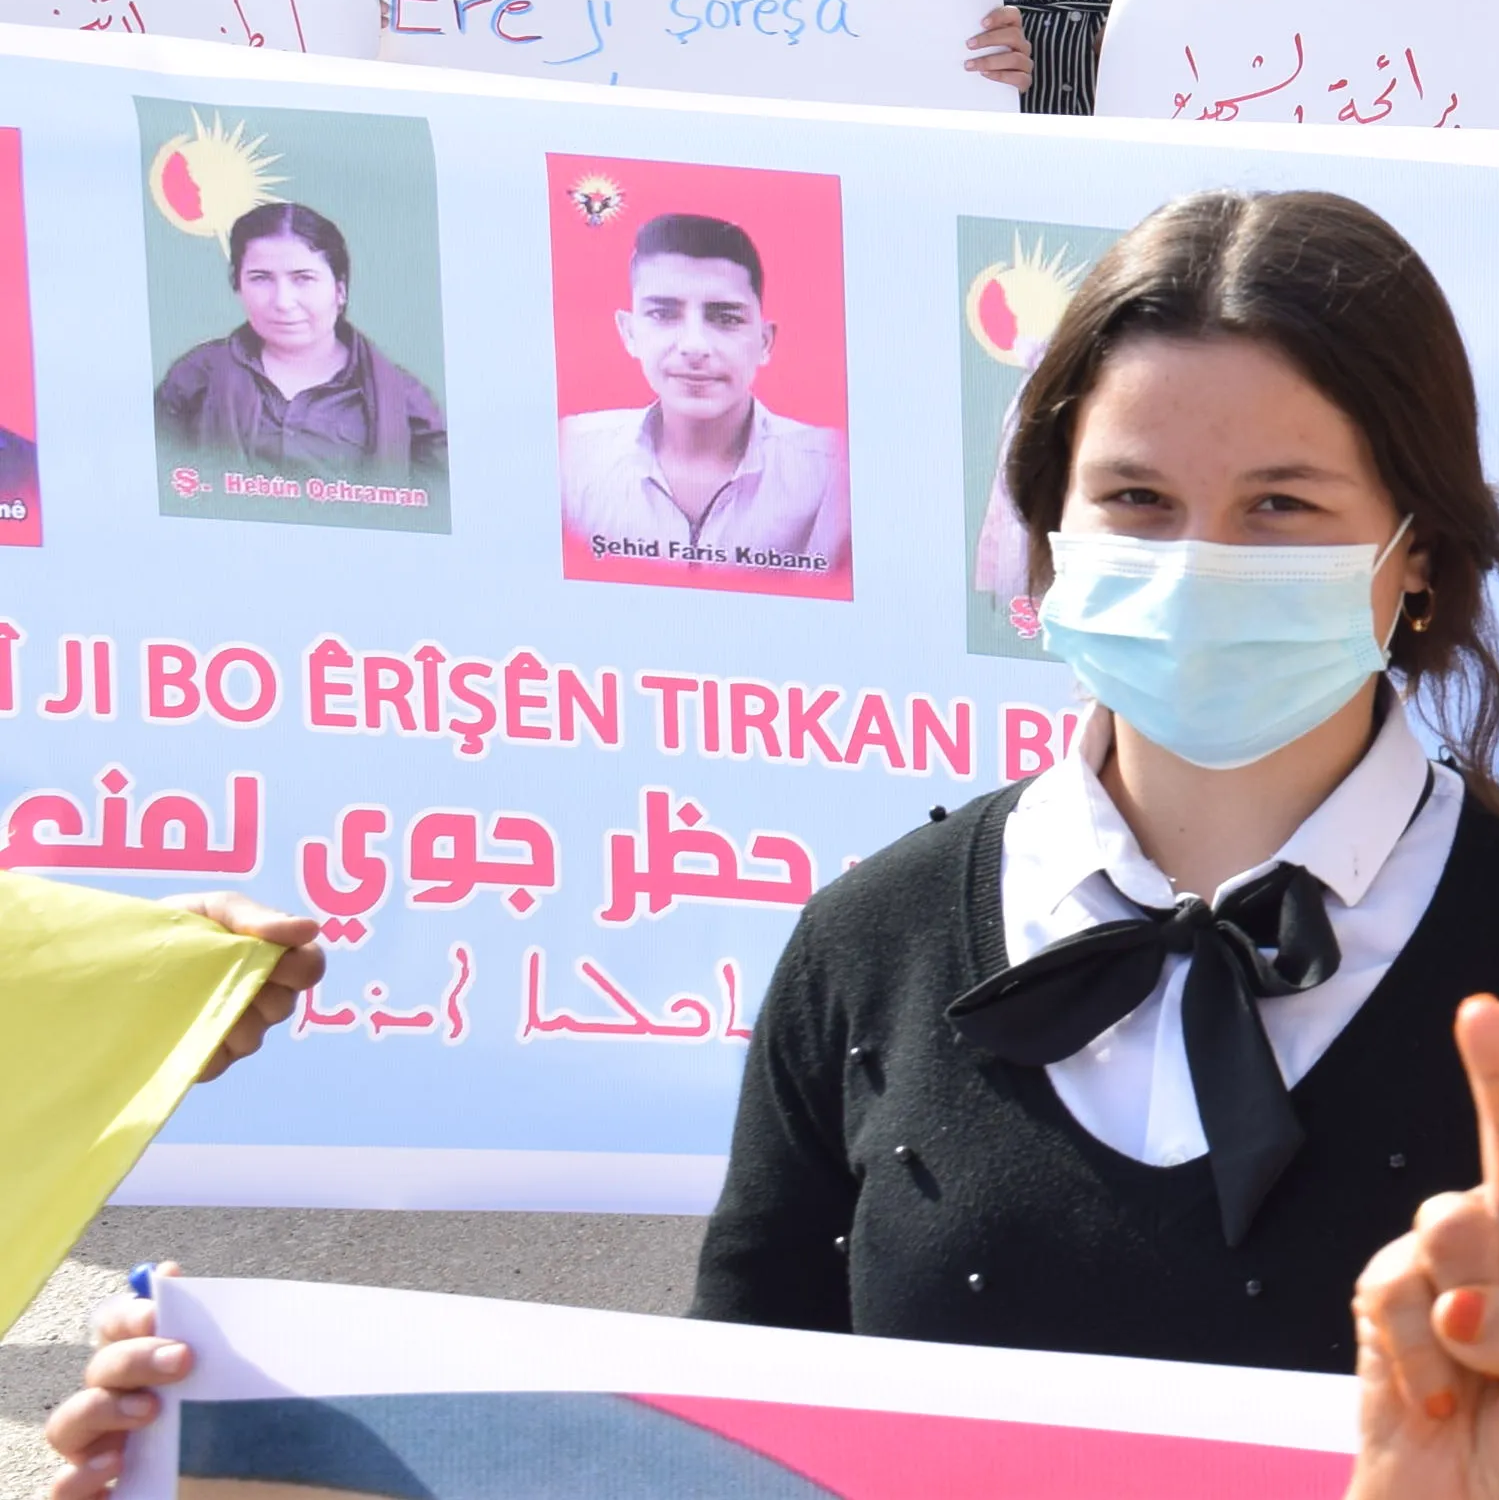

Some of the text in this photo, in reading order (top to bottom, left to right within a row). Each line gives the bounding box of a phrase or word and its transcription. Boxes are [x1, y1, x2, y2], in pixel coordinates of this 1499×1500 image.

[44, 639, 112, 716] JI
[147, 643, 277, 723] BO
[308, 639, 619, 756] ÊRÎŞÊN
[641, 674, 972, 776] TIRKAN
[303, 808, 556, 943] جوي
[601, 790, 813, 923] حظر
